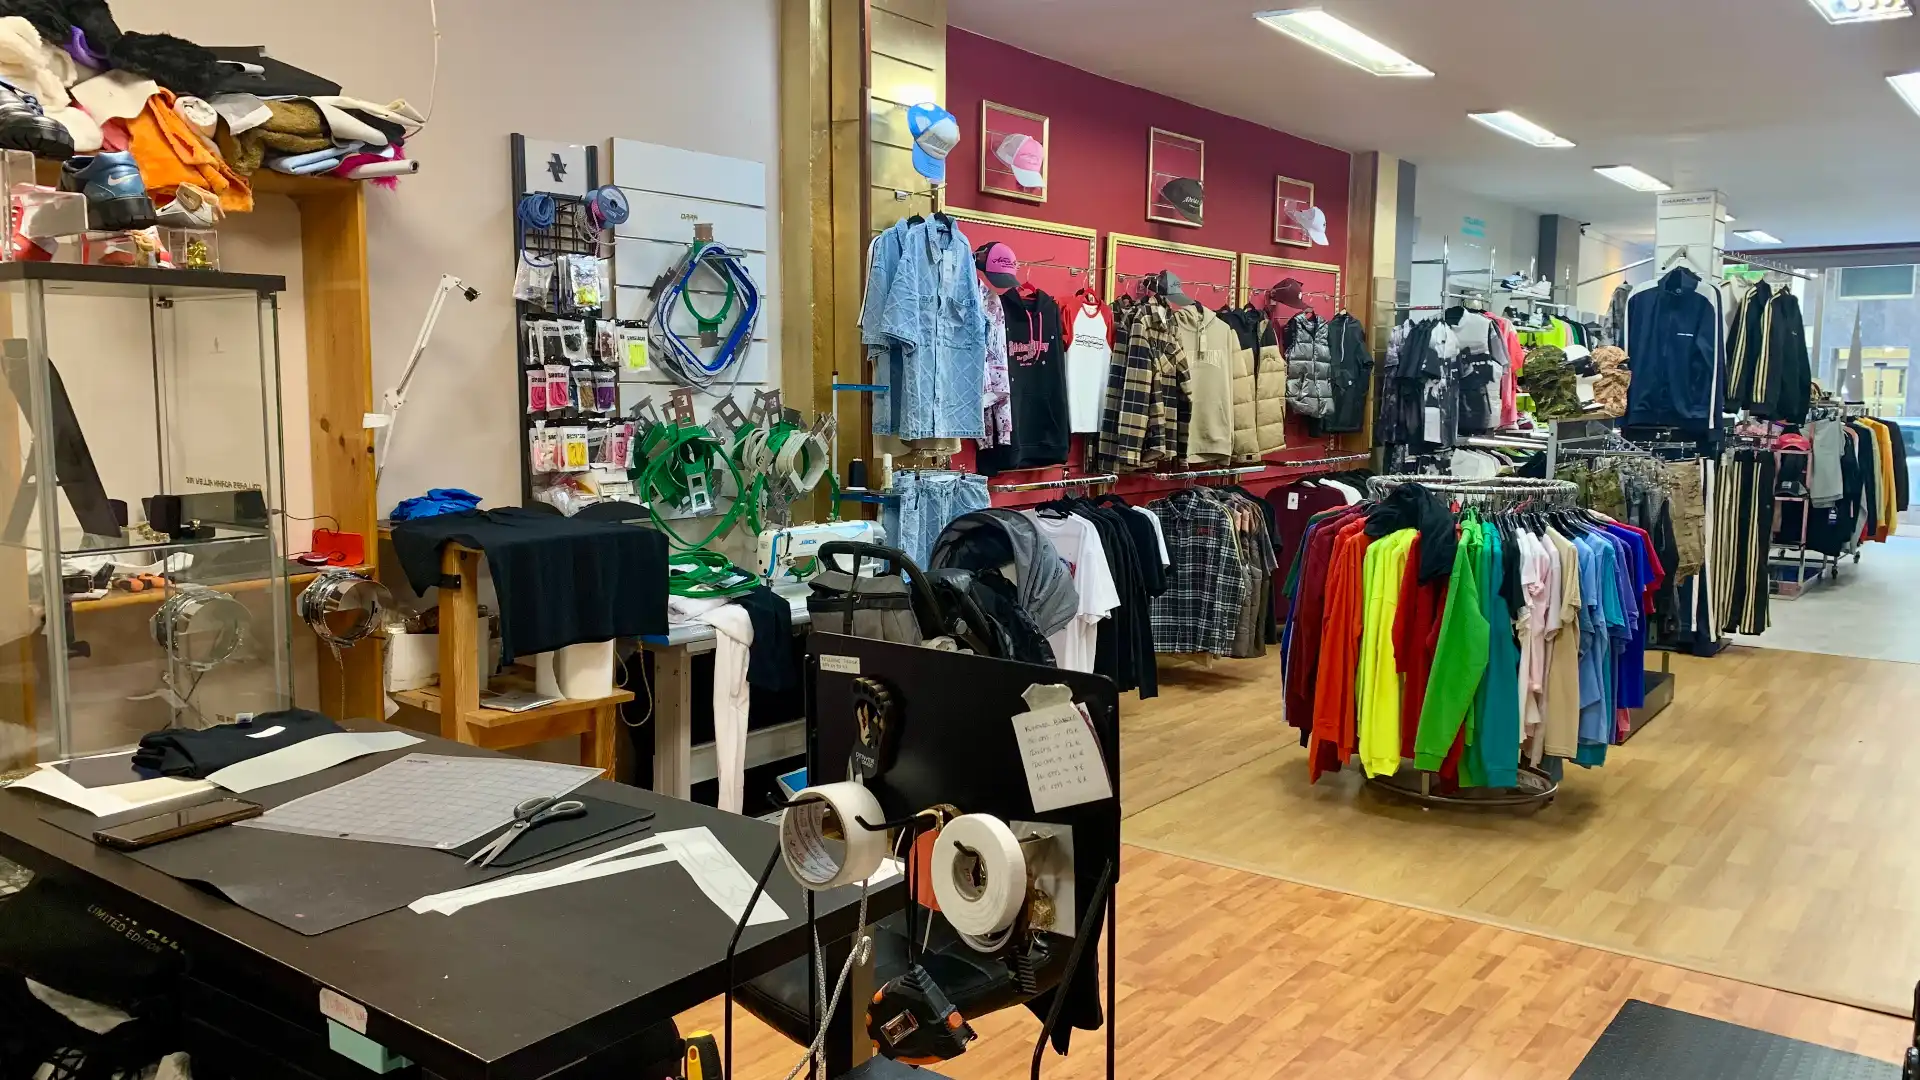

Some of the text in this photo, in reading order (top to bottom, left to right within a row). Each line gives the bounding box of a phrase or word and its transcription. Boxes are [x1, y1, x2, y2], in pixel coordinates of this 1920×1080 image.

[855, 751, 875, 764] DENVER
[87, 904, 126, 932] LIMITED
[125, 928, 163, 953] EDITION
